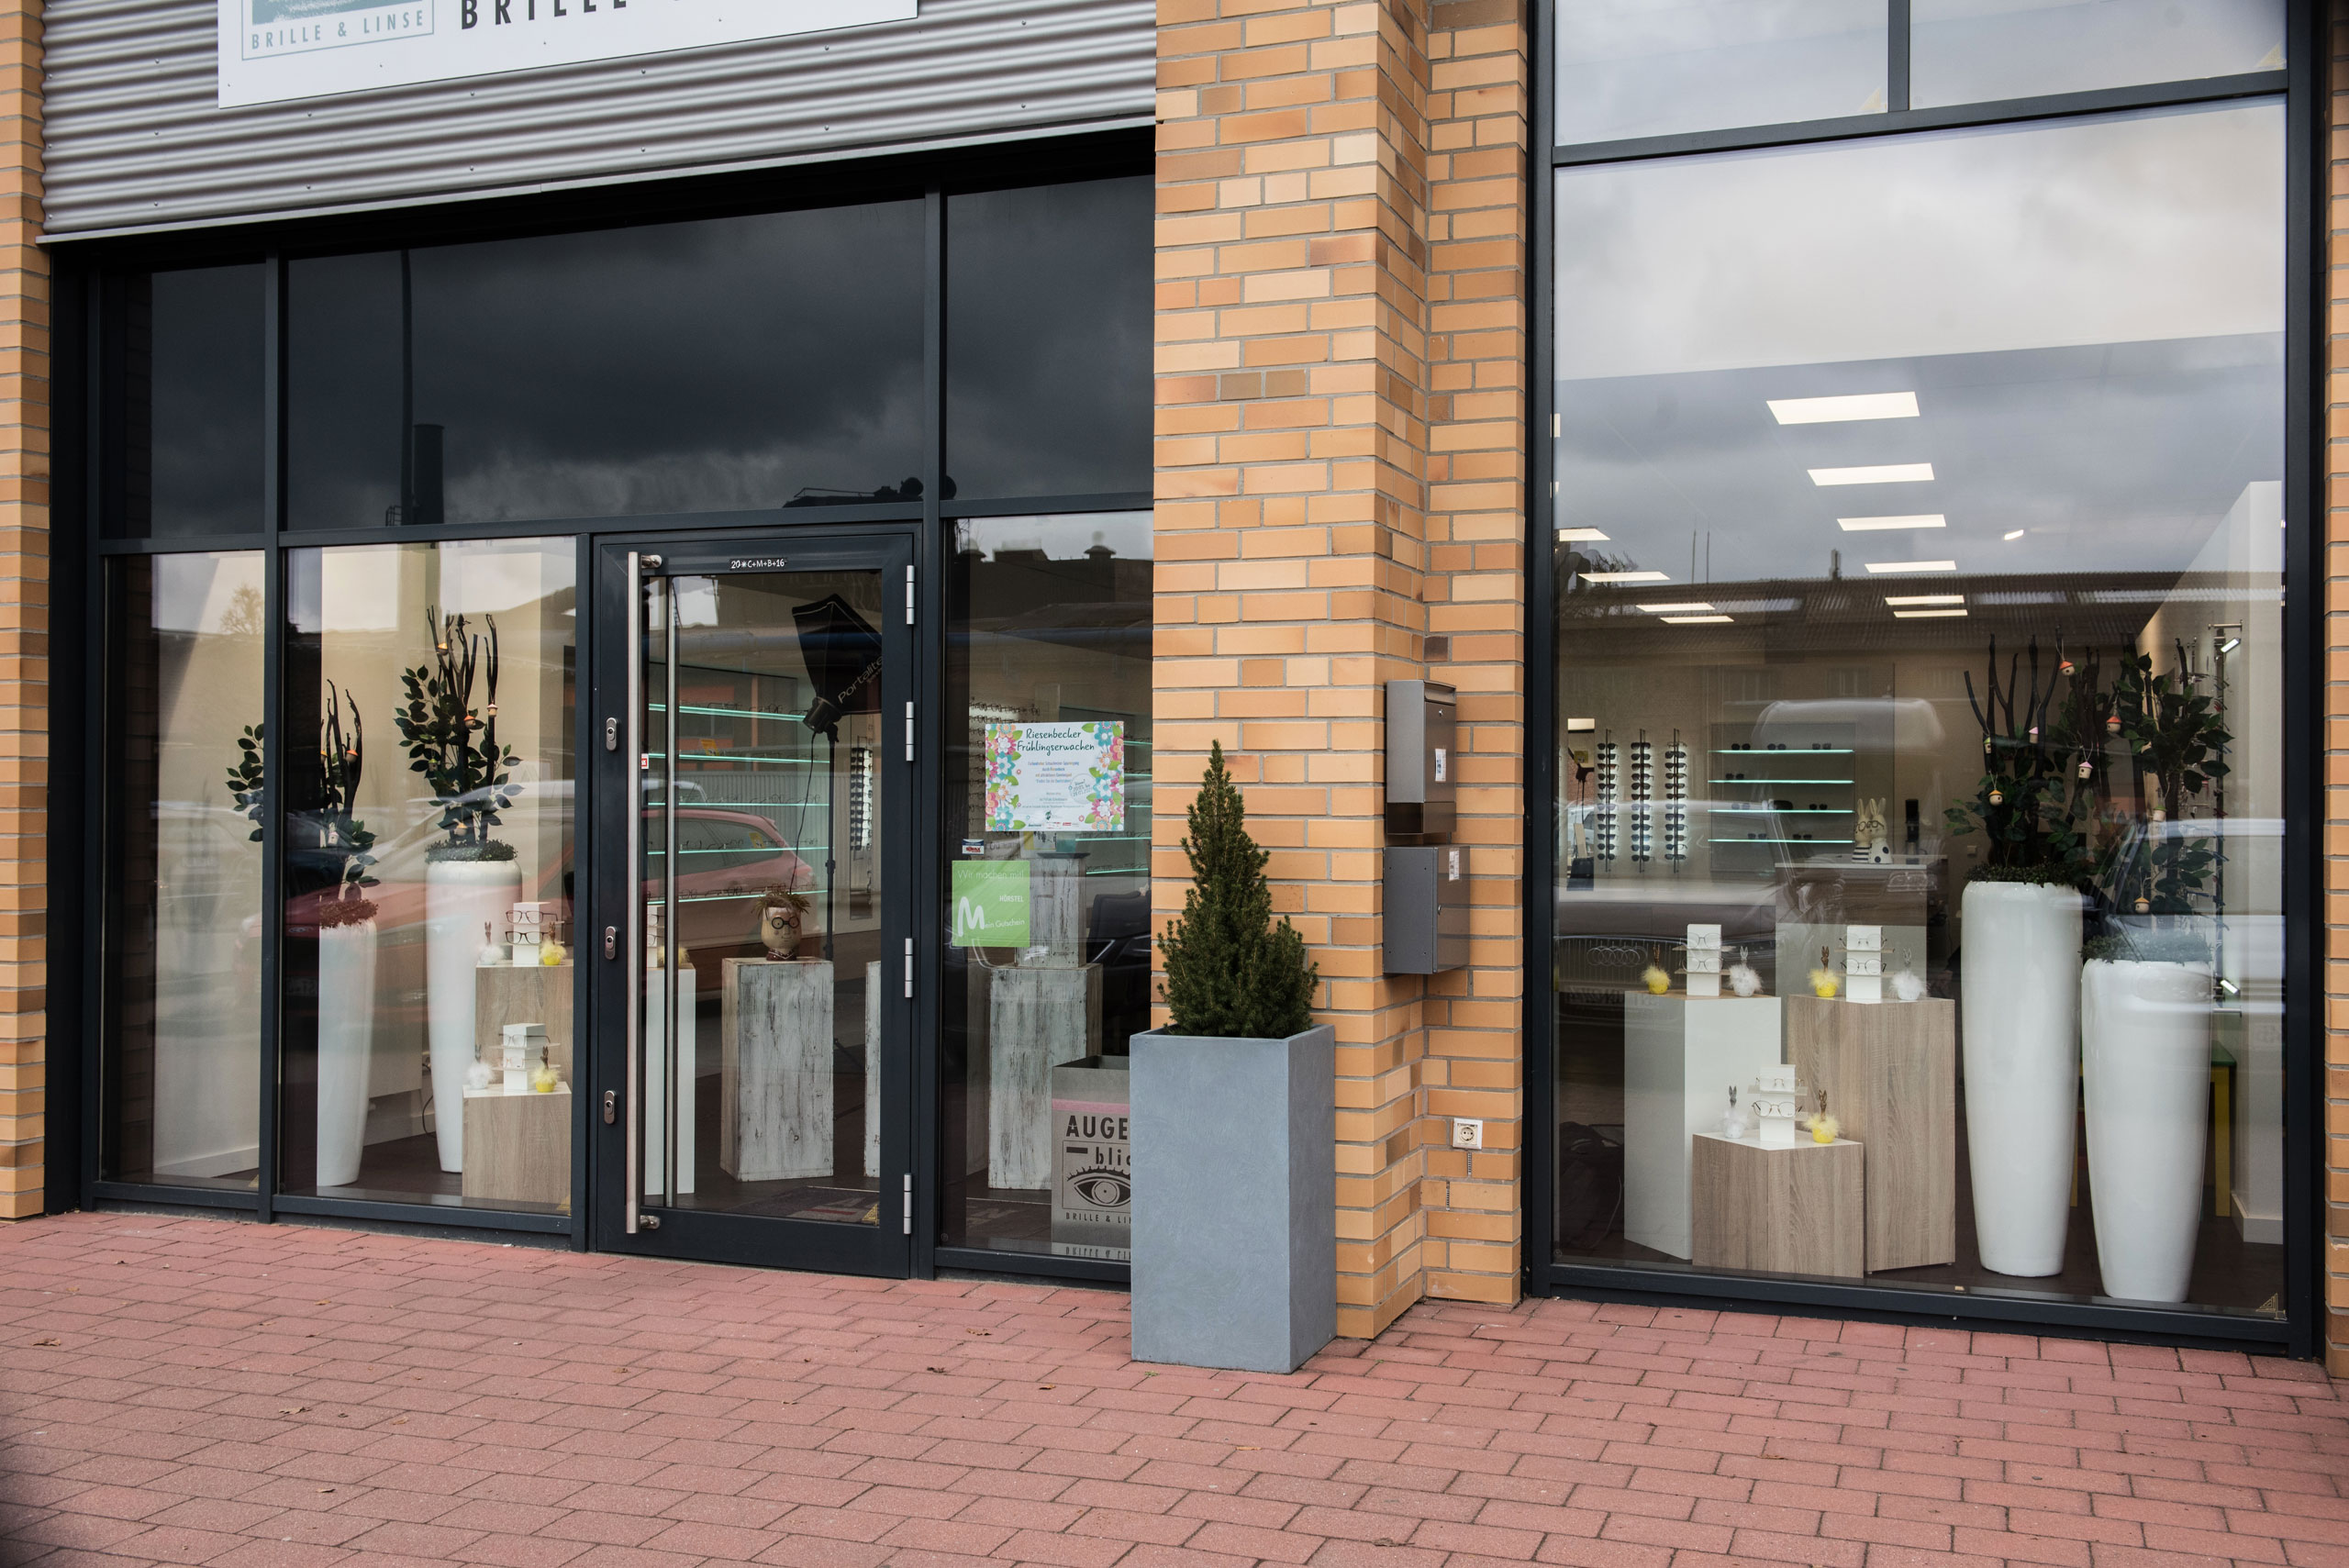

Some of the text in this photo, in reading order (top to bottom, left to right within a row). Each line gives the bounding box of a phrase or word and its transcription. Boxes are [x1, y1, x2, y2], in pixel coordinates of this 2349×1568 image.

[462, 0, 627, 29] BRIL
[251, 10, 423, 50] BRILLE & LINSE
[1026, 728, 1082, 740] Riesenbecker
[1017, 740, 1095, 756] Frühlingserwachen
[957, 869, 973, 880] Wir
[975, 869, 1008, 880] machen
[999, 894, 1024, 903] HÖRSTEL
[996, 917, 1025, 929] Gutschein
[1065, 1212, 1099, 1222] BRILLE
